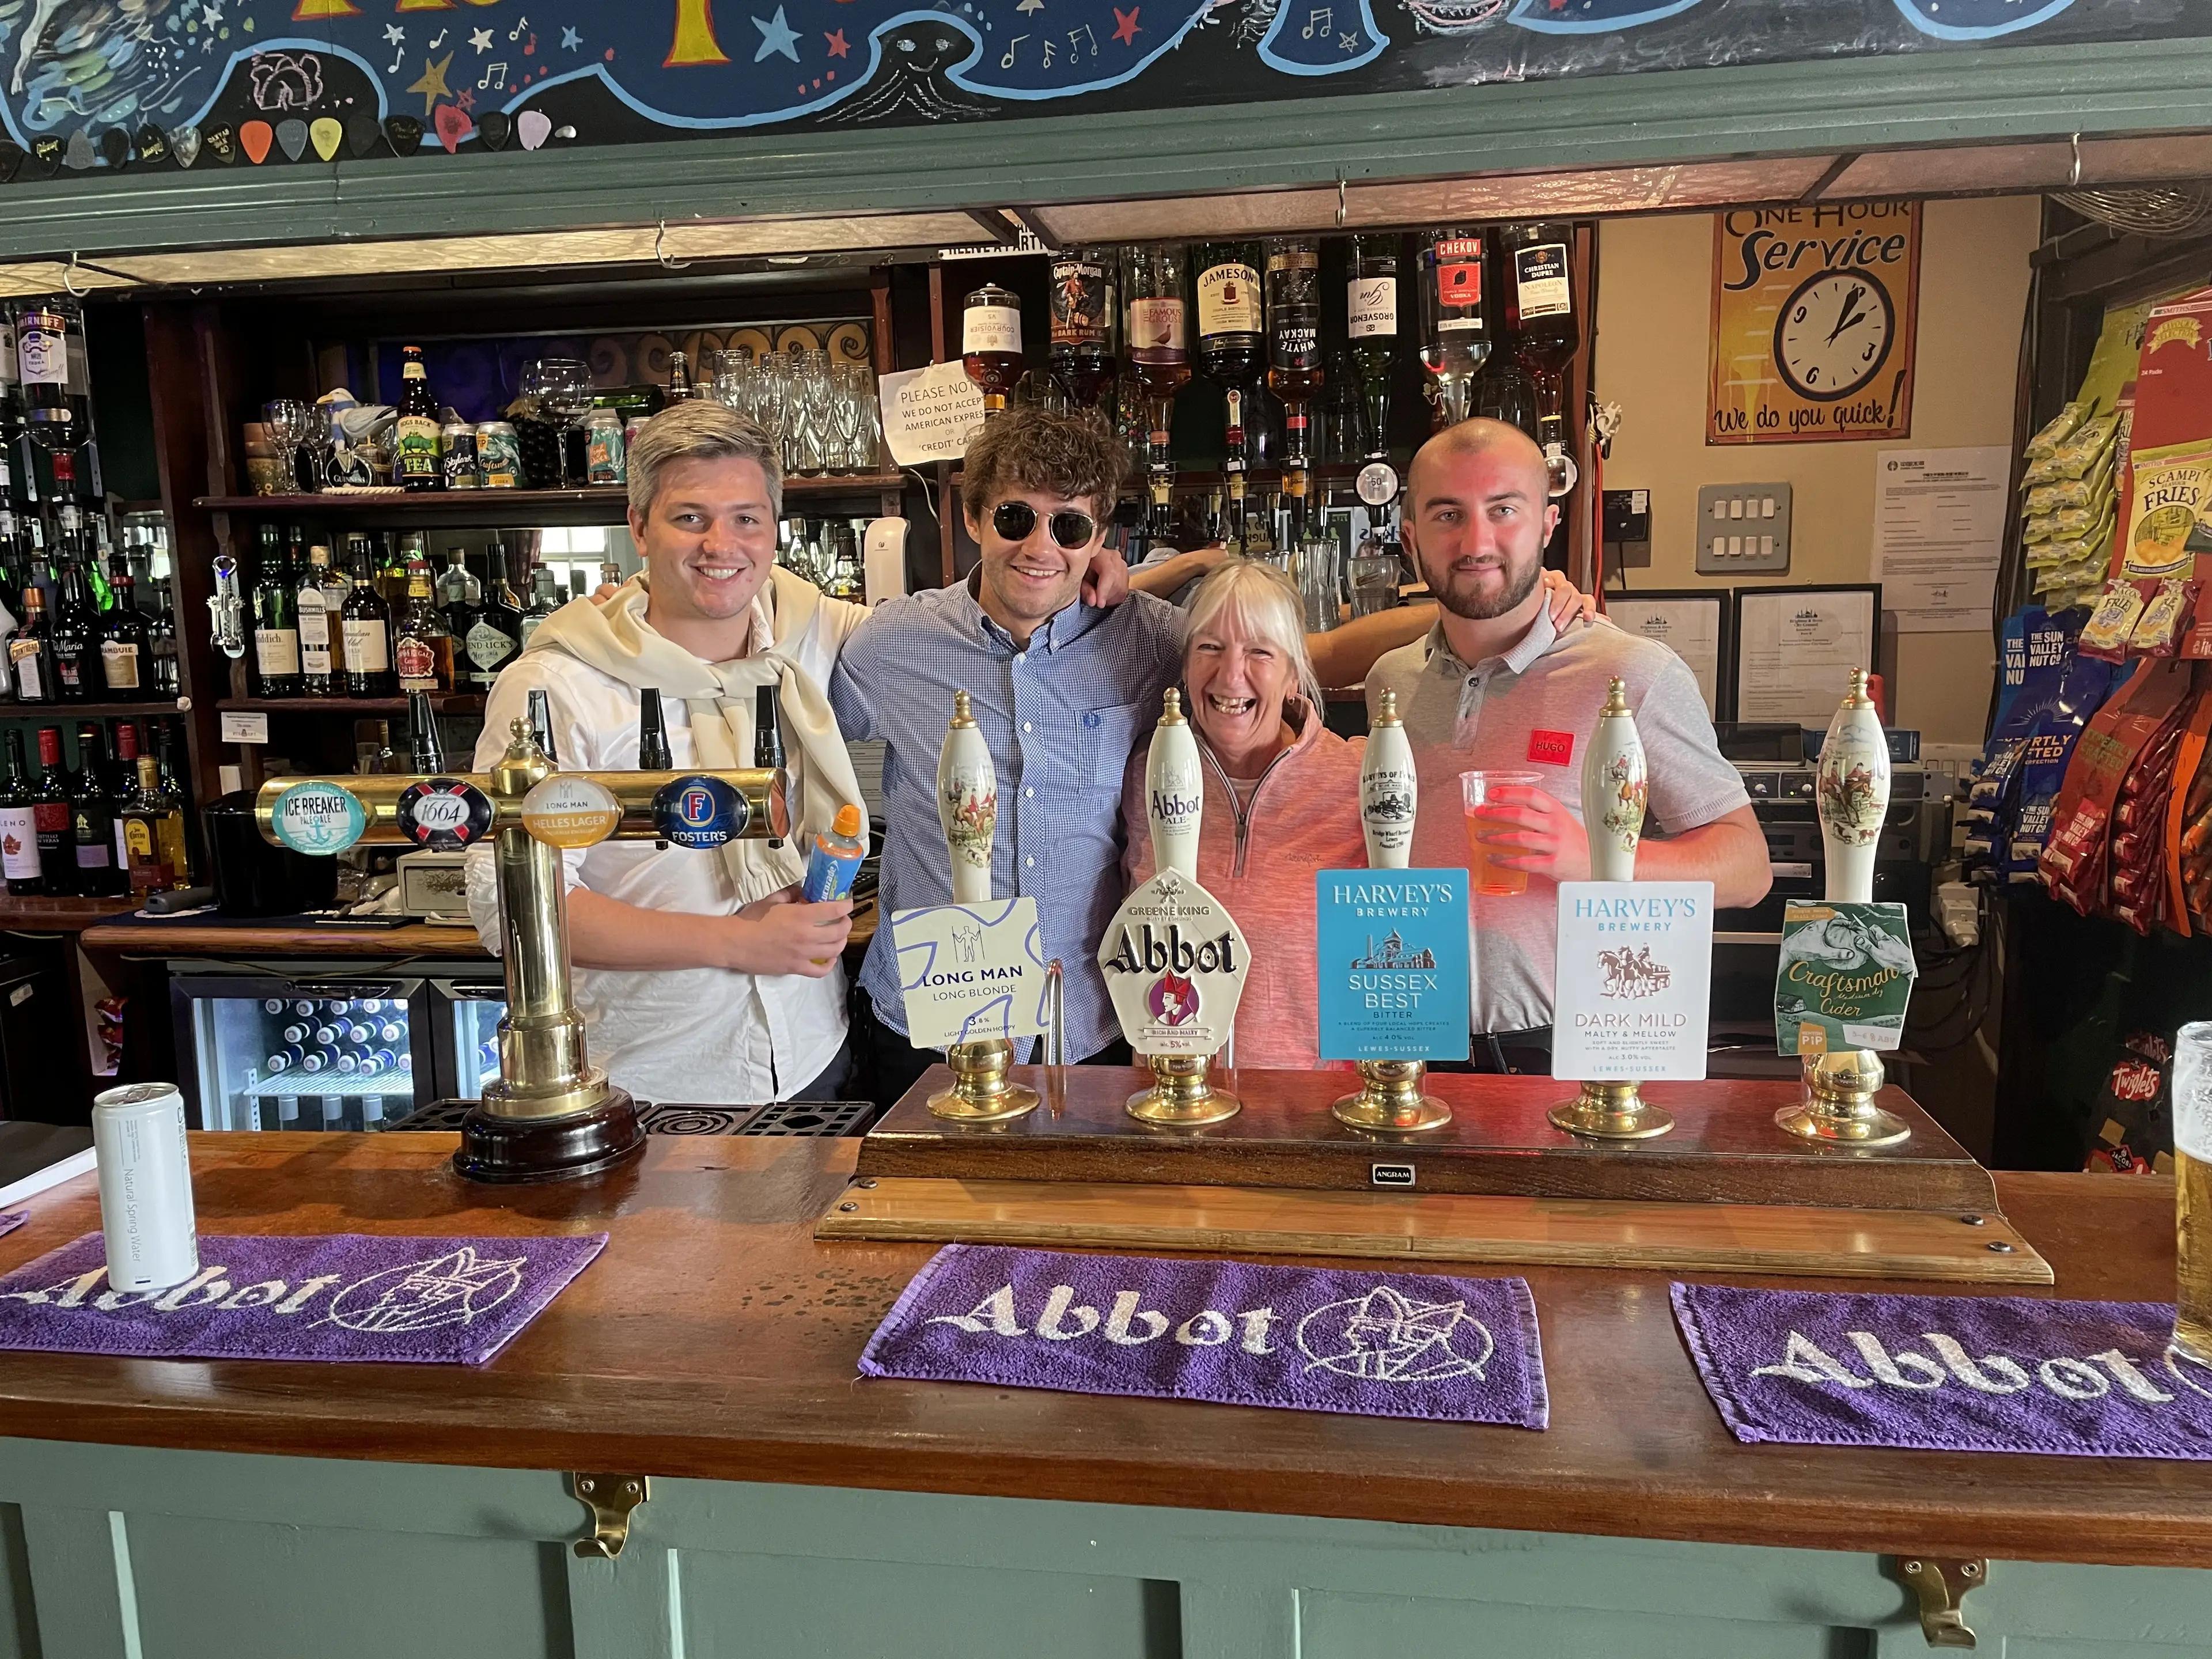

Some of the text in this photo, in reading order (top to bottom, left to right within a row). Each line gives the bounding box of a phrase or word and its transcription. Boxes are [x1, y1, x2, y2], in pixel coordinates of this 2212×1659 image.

[1725, 202, 1910, 237] ONE HOUR
[1440, 241, 1478, 255] CHEKOV
[1524, 263, 1559, 273] CHRISTIAN
[1724, 230, 1905, 290] Service
[1054, 263, 1101, 279] Captain Morgan
[1203, 268, 1253, 287] JAMESON
[1531, 270, 1554, 278] DUPRE
[1359, 282, 1389, 306] Gin
[1350, 313, 1394, 324] GROSVENOR
[1794, 306, 1807, 323] 9
[1279, 328, 1316, 340] MACKAY
[1281, 340, 1316, 353] WHYTE
[1806, 366, 1820, 384] 6
[901, 381, 975, 403] PLEASE NOT
[1714, 369, 1907, 434] We do you quick!
[902, 410, 916, 418] WE
[919, 407, 931, 416] DO
[934, 403, 952, 413] NOT
[415, 419, 431, 428] BACK
[906, 410, 984, 431] AMERICAN EXPRES
[404, 458, 433, 472] TEA
[1371, 478, 1382, 486] 50
[2149, 469, 2200, 489] SCAMPI
[2143, 487, 2200, 512] FRIES
[467, 641, 513, 649] ENDRICK'S
[2006, 639, 2024, 649] THE
[2044, 631, 2063, 643] SUN
[58, 640, 84, 652] Maria
[2030, 642, 2063, 655] VALLEY
[2029, 655, 2049, 667] NUT
[1536, 741, 1565, 752] HUGO
[285, 797, 346, 816] ICE BREAKER
[421, 801, 463, 822] 1664
[688, 793, 705, 820] F
[1152, 790, 1199, 820] Abbot
[300, 815, 331, 825] PALE ALE
[532, 816, 606, 828] HELLES LAGER
[2022, 814, 2050, 824] VALLEY
[672, 831, 728, 842] FOSTER'S
[2020, 824, 2036, 834] NUT
[1334, 884, 1452, 904] HARVEY'S
[1128, 906, 1210, 915] GREENE KING
[1356, 907, 1429, 917] BREWERY
[1575, 899, 1695, 918] HARVEY'S
[1598, 922, 1671, 931] BREWERY
[1104, 923, 1237, 974] Abbot
[923, 965, 1022, 987] LONG MAN
[1349, 975, 1438, 990] SUSSEX
[1789, 961, 1899, 998] Craftsman
[933, 984, 1017, 1001] LONG BLONDE
[1365, 993, 1422, 1009] BEST
[1821, 998, 1862, 1016] Cider
[1575, 1013, 1687, 1028] DARK MILD
[1802, 1036, 1823, 1046] PIP
[2113, 1067, 2160, 1099] Twiglets
[124, 1168, 135, 1204] Natural
[126, 1204, 138, 1234] Spring
[131, 1234, 141, 1262] Water
[925, 1282, 1281, 1356] Abbot
[1751, 1329, 2175, 1403] Abbot
